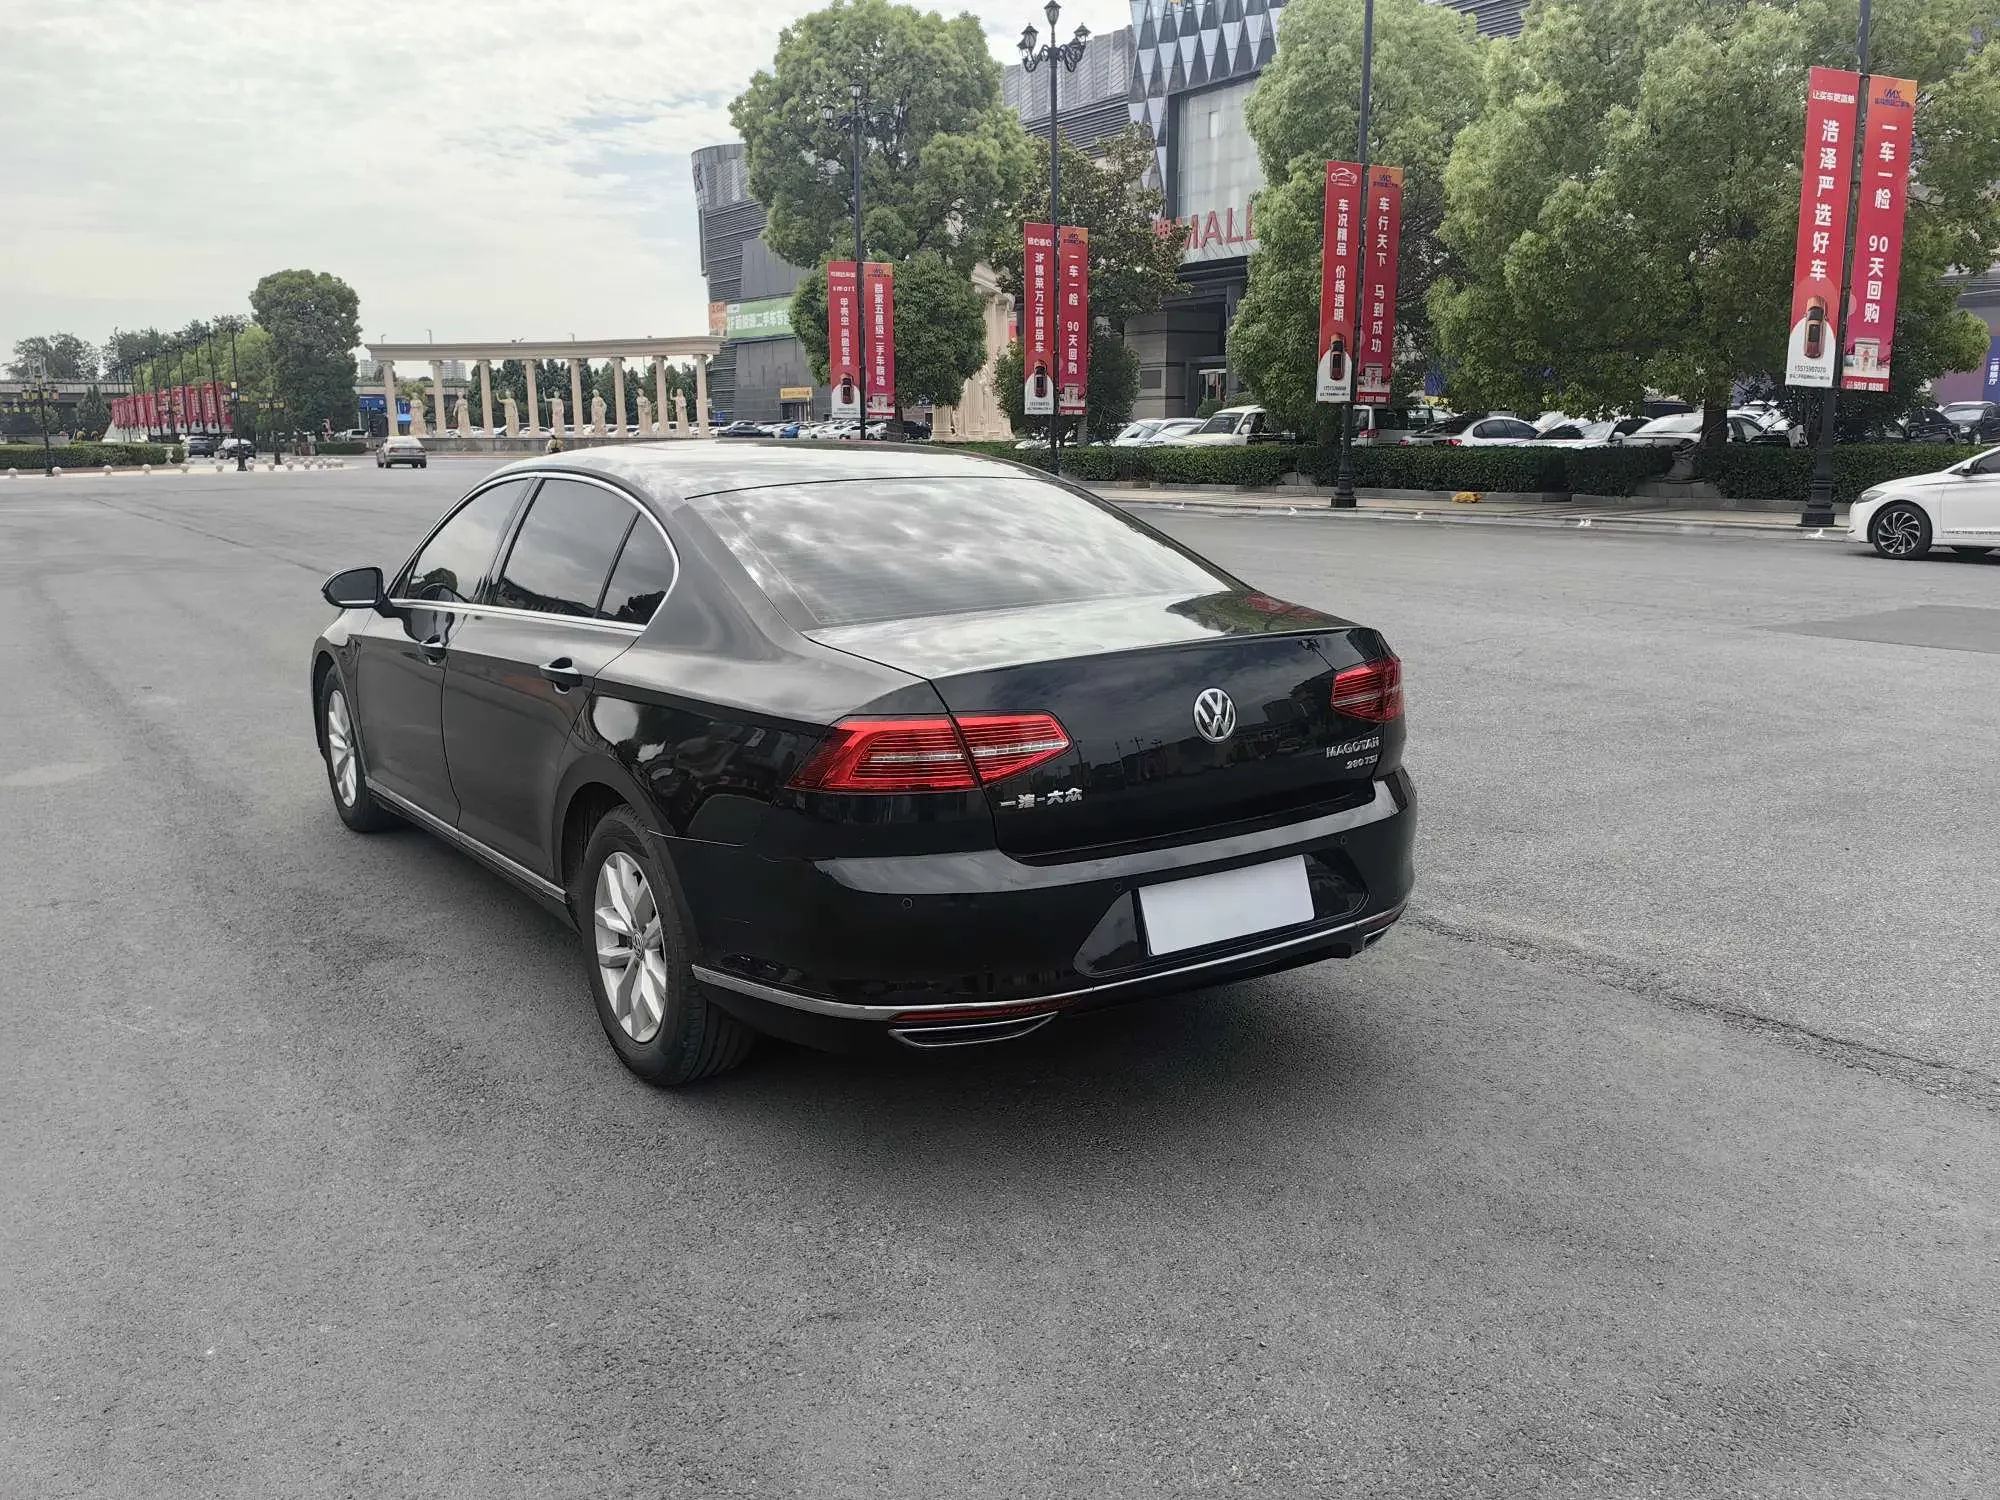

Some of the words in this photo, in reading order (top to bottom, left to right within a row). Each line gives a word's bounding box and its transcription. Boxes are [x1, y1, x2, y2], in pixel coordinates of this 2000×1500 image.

[1875, 124, 1898, 209] 一车一检
[1336, 198, 1349, 256] 车况精品
[1809, 118, 1840, 281] 浩泽严选好车
[1376, 197, 1390, 268] 车行天下
[1068, 255, 1079, 306] 一车一检
[1333, 265, 1346, 322] 价格透明
[1864, 235, 1889, 324] 90天回购
[1067, 321, 1080, 375] 90天回购
[1371, 284, 1385, 353] 马到成功
[1326, 736, 1379, 758] MAGOTAN
